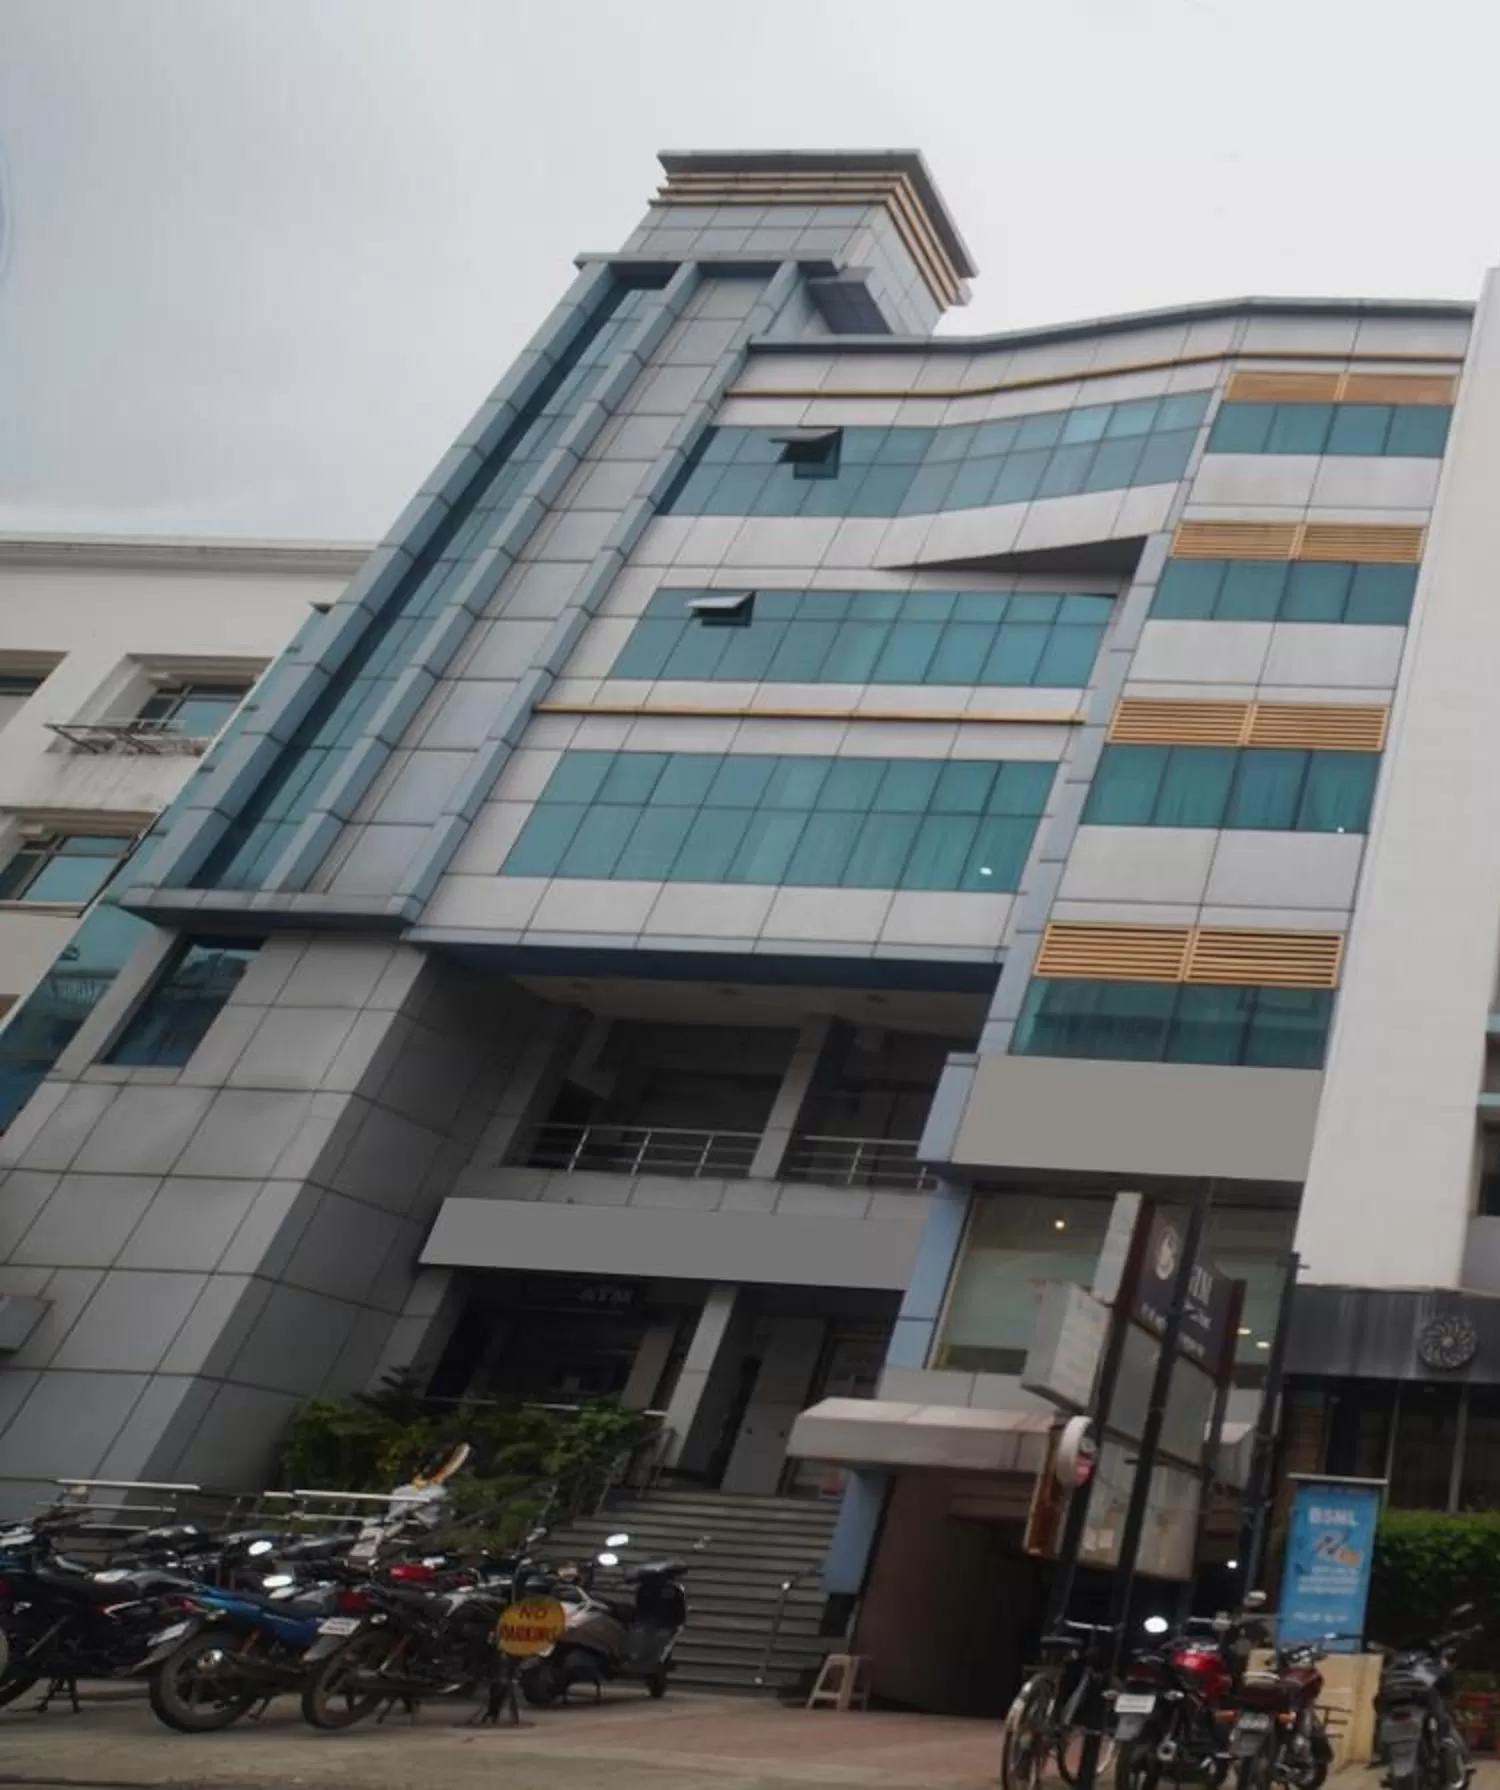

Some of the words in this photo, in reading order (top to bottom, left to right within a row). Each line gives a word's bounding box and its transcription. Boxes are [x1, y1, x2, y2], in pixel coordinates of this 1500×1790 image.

[577, 1285, 633, 1304] ATM
[1309, 1507, 1359, 1527] BSNL
[519, 1605, 549, 1619] NO
[500, 1624, 558, 1643] PARKING
